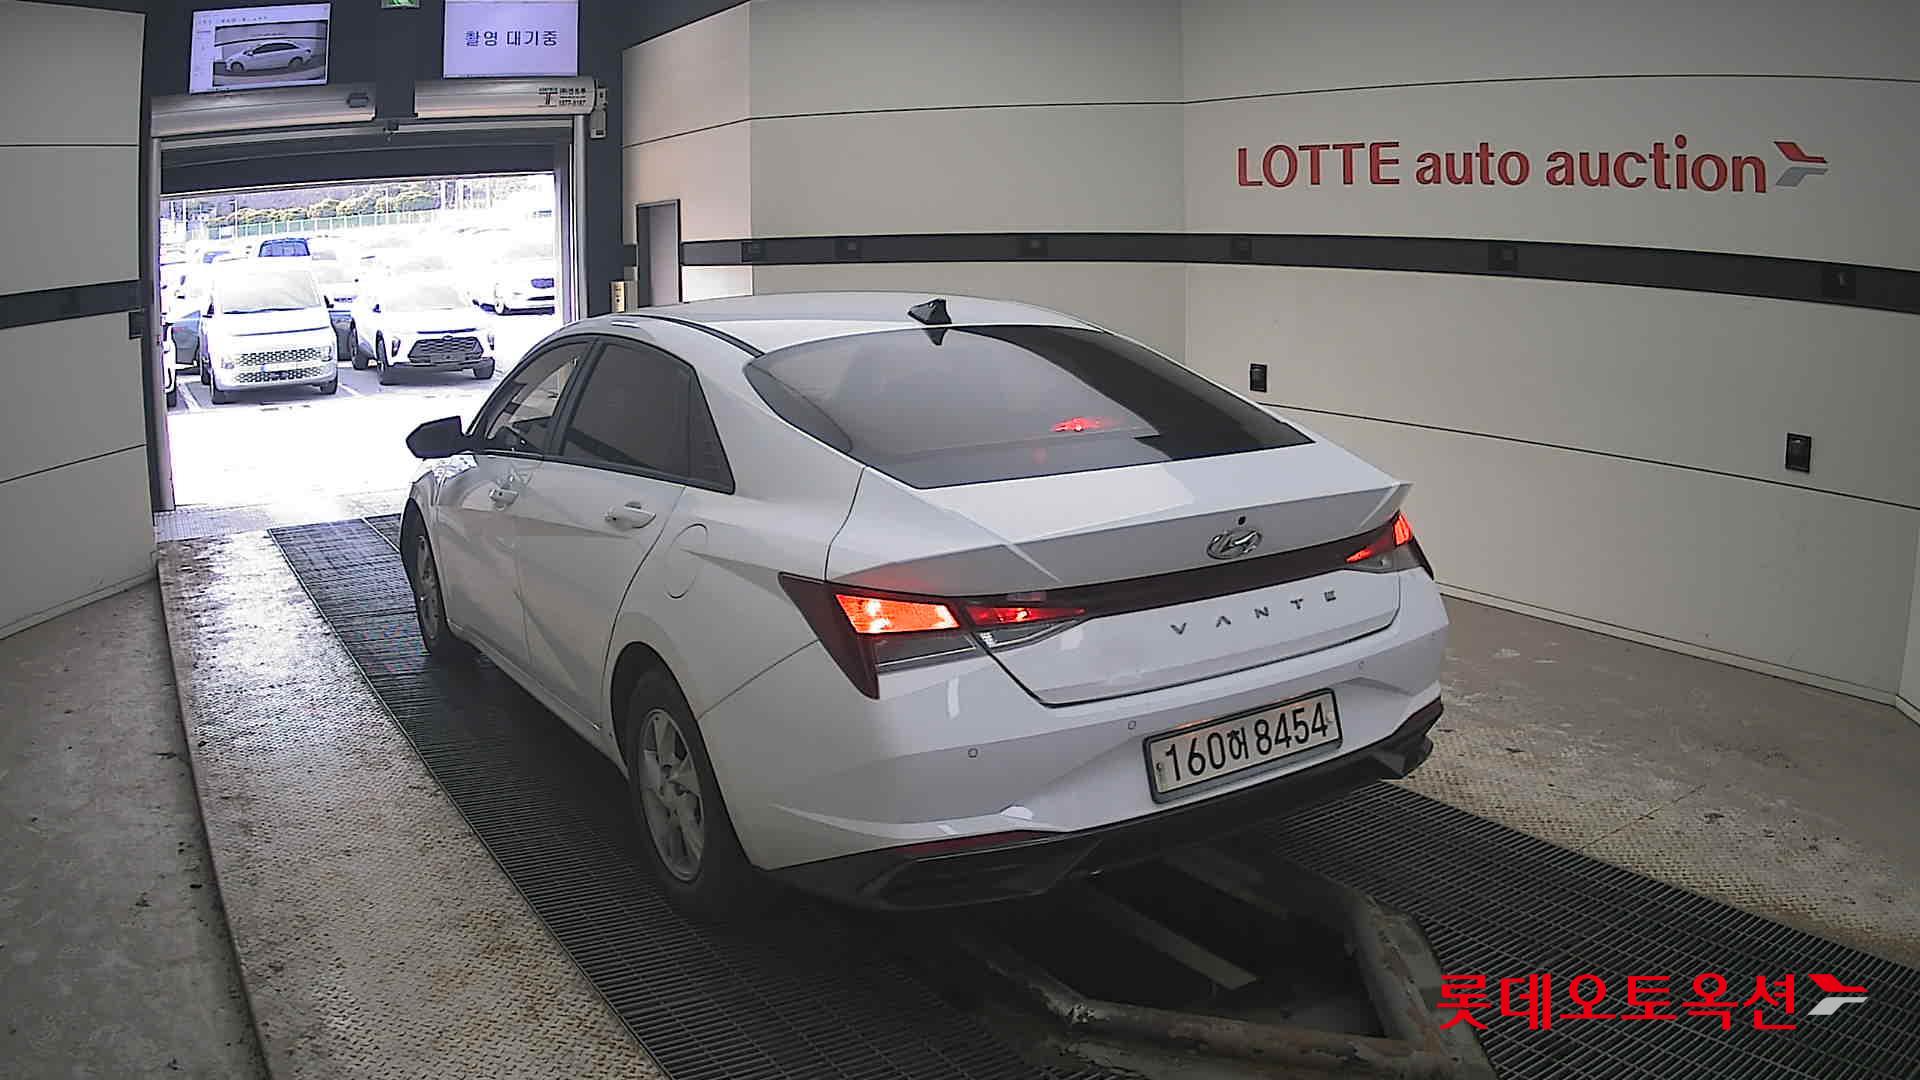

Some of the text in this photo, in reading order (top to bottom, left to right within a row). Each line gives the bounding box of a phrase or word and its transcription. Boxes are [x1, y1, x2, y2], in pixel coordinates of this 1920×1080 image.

[465, 31, 557, 47] 촬영 대기중
[1237, 133, 1768, 194] LOTTE auto auction
[1170, 590, 1337, 635] VANTE
